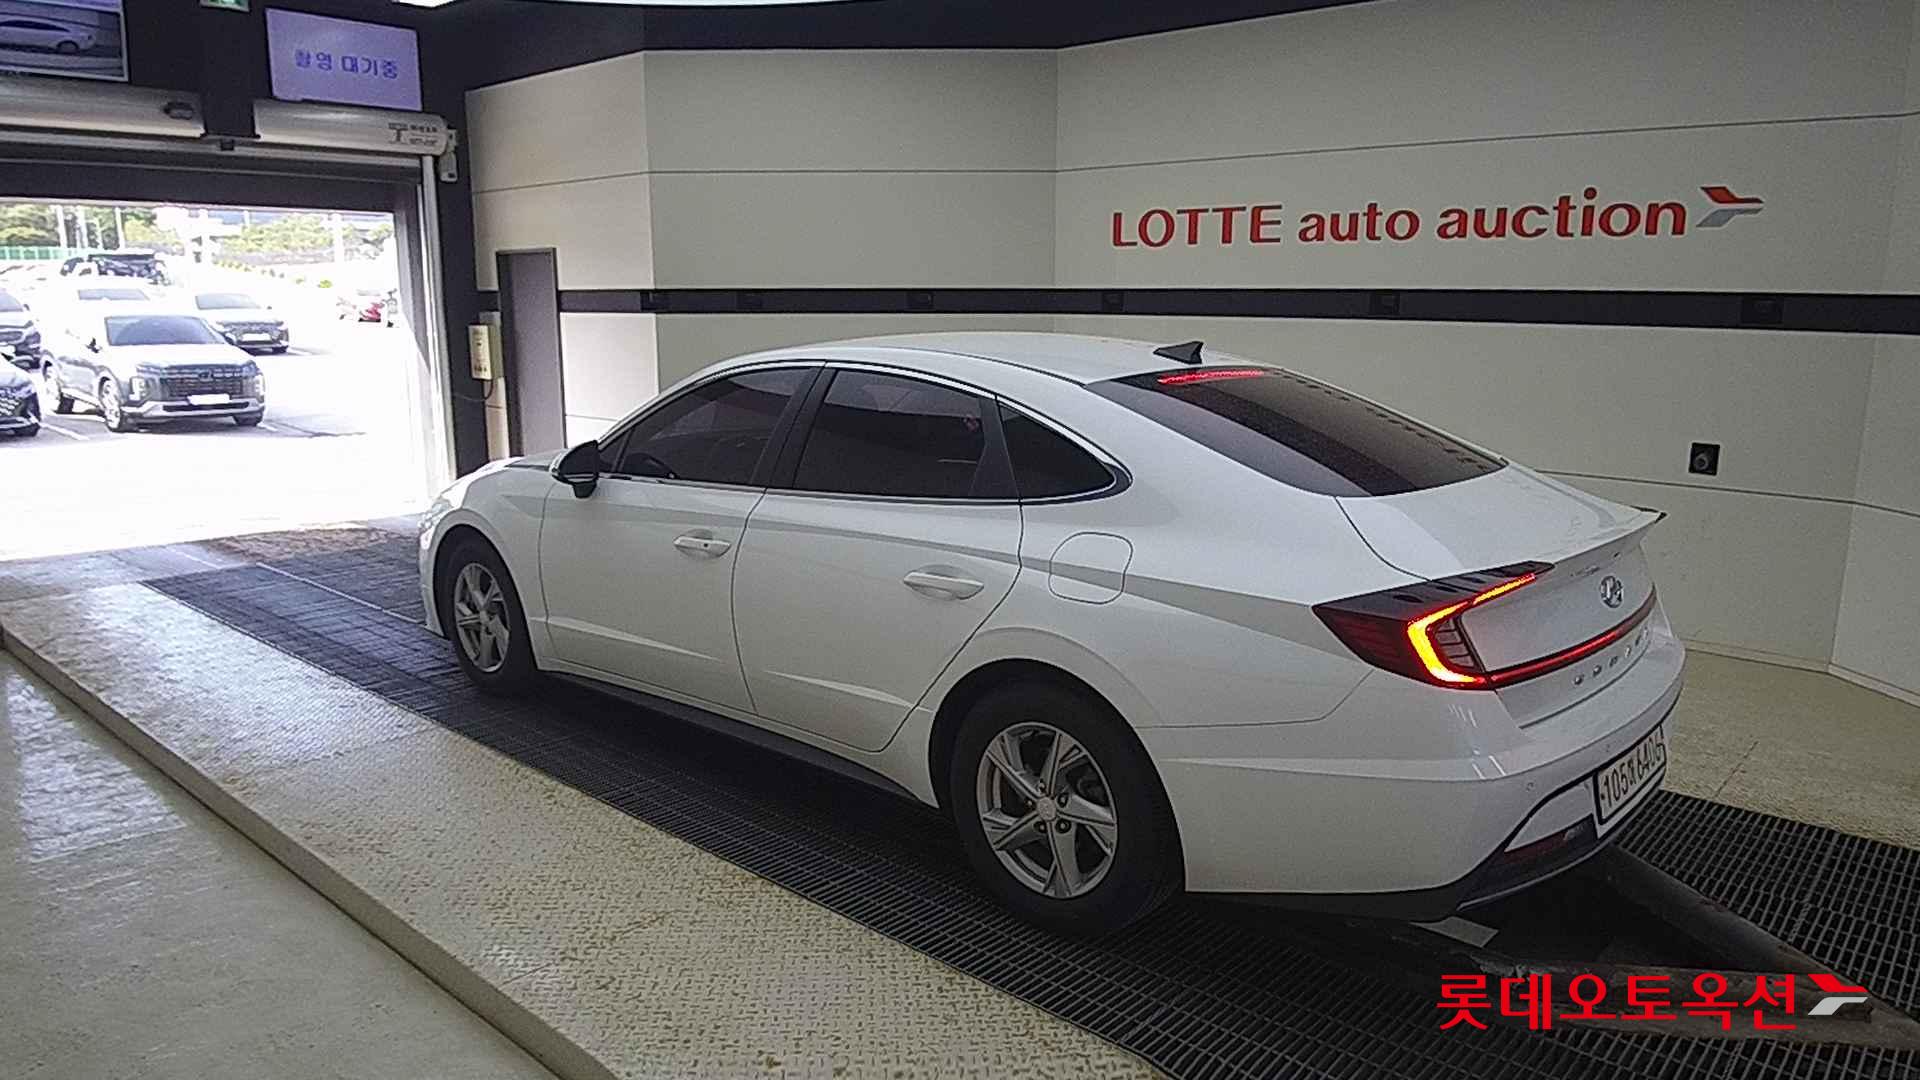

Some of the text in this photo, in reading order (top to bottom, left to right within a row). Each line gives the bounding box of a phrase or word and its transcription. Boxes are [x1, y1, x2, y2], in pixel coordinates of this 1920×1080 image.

[341, 54, 398, 79] 대기중
[1112, 186, 1687, 247] LOTTE auto auction
